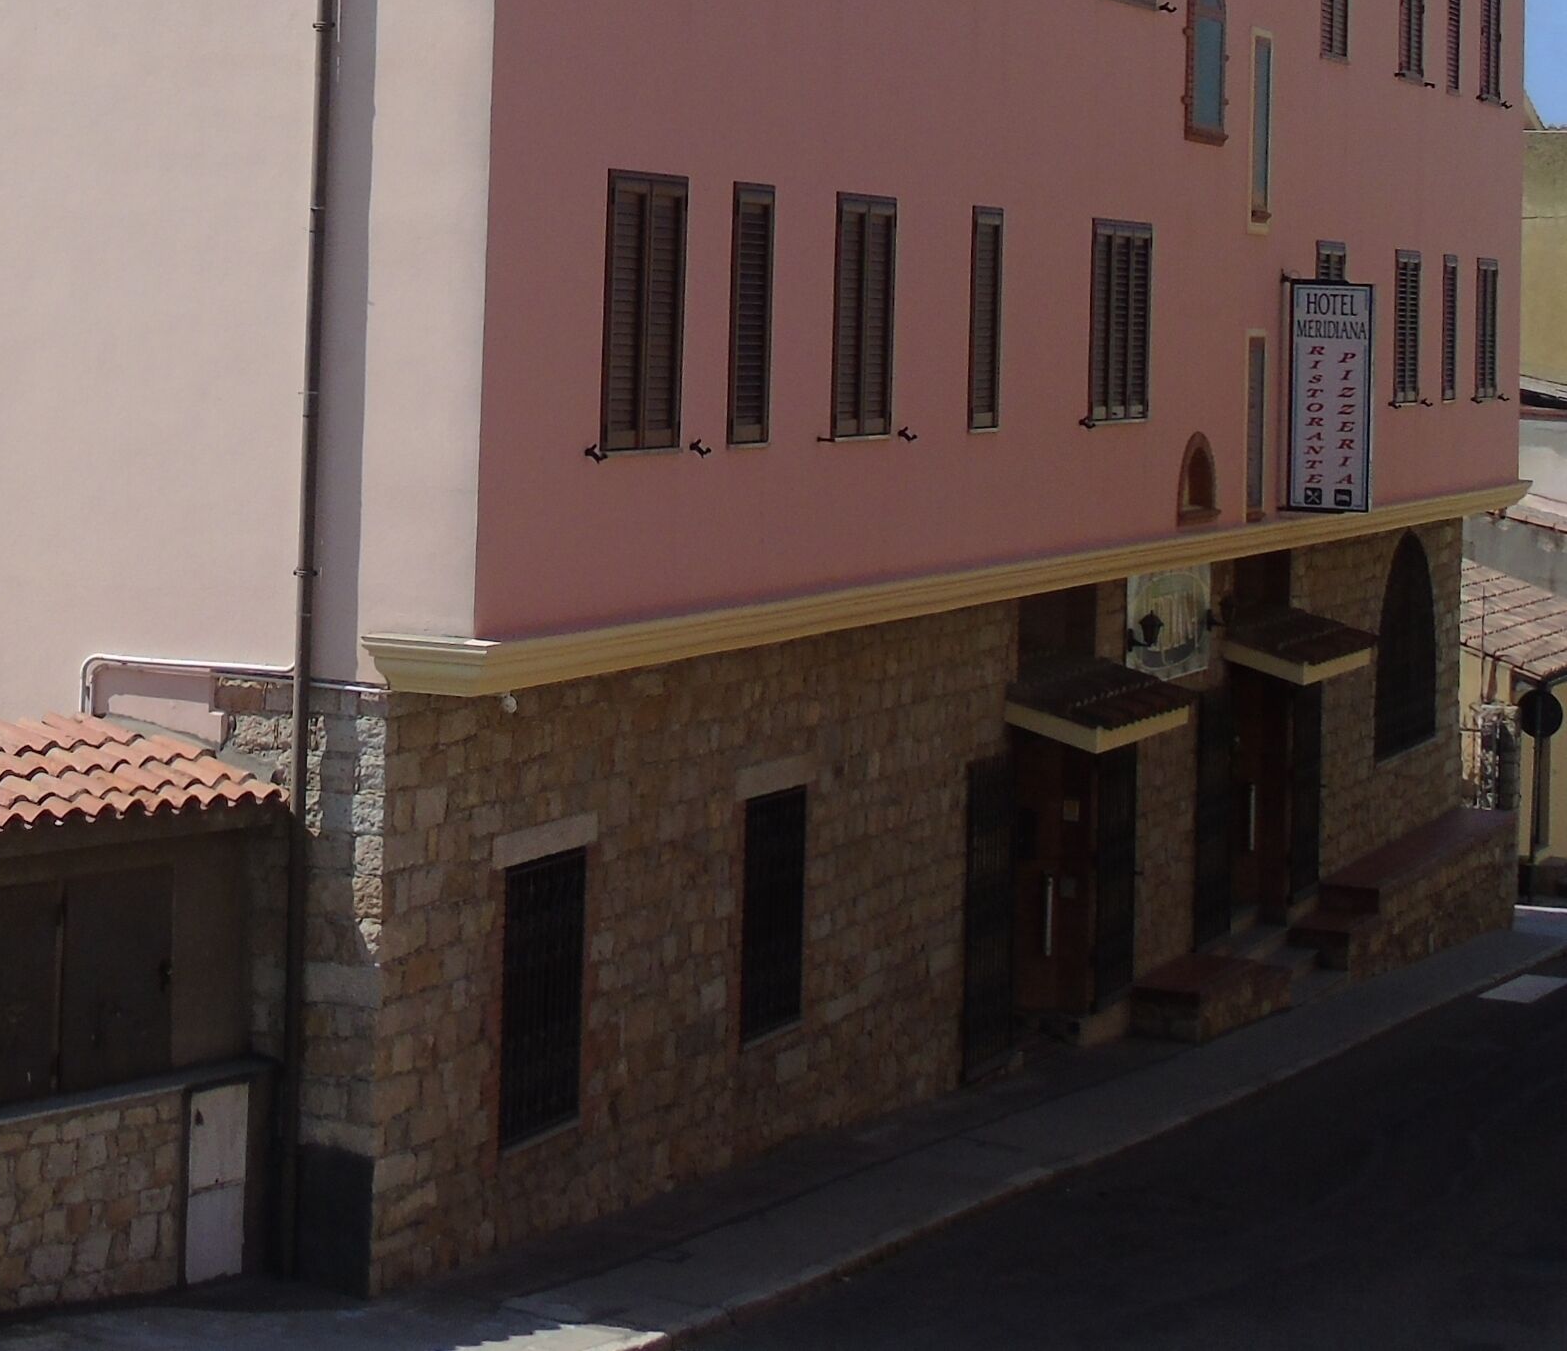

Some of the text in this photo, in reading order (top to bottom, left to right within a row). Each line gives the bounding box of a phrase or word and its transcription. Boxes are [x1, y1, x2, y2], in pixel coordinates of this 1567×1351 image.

[1296, 319, 1367, 340] MERIDIANA
[1305, 292, 1358, 316] HOTEL
[1303, 345, 1326, 485] RISTORANTE
[1335, 352, 1357, 485] PIZZERIA
